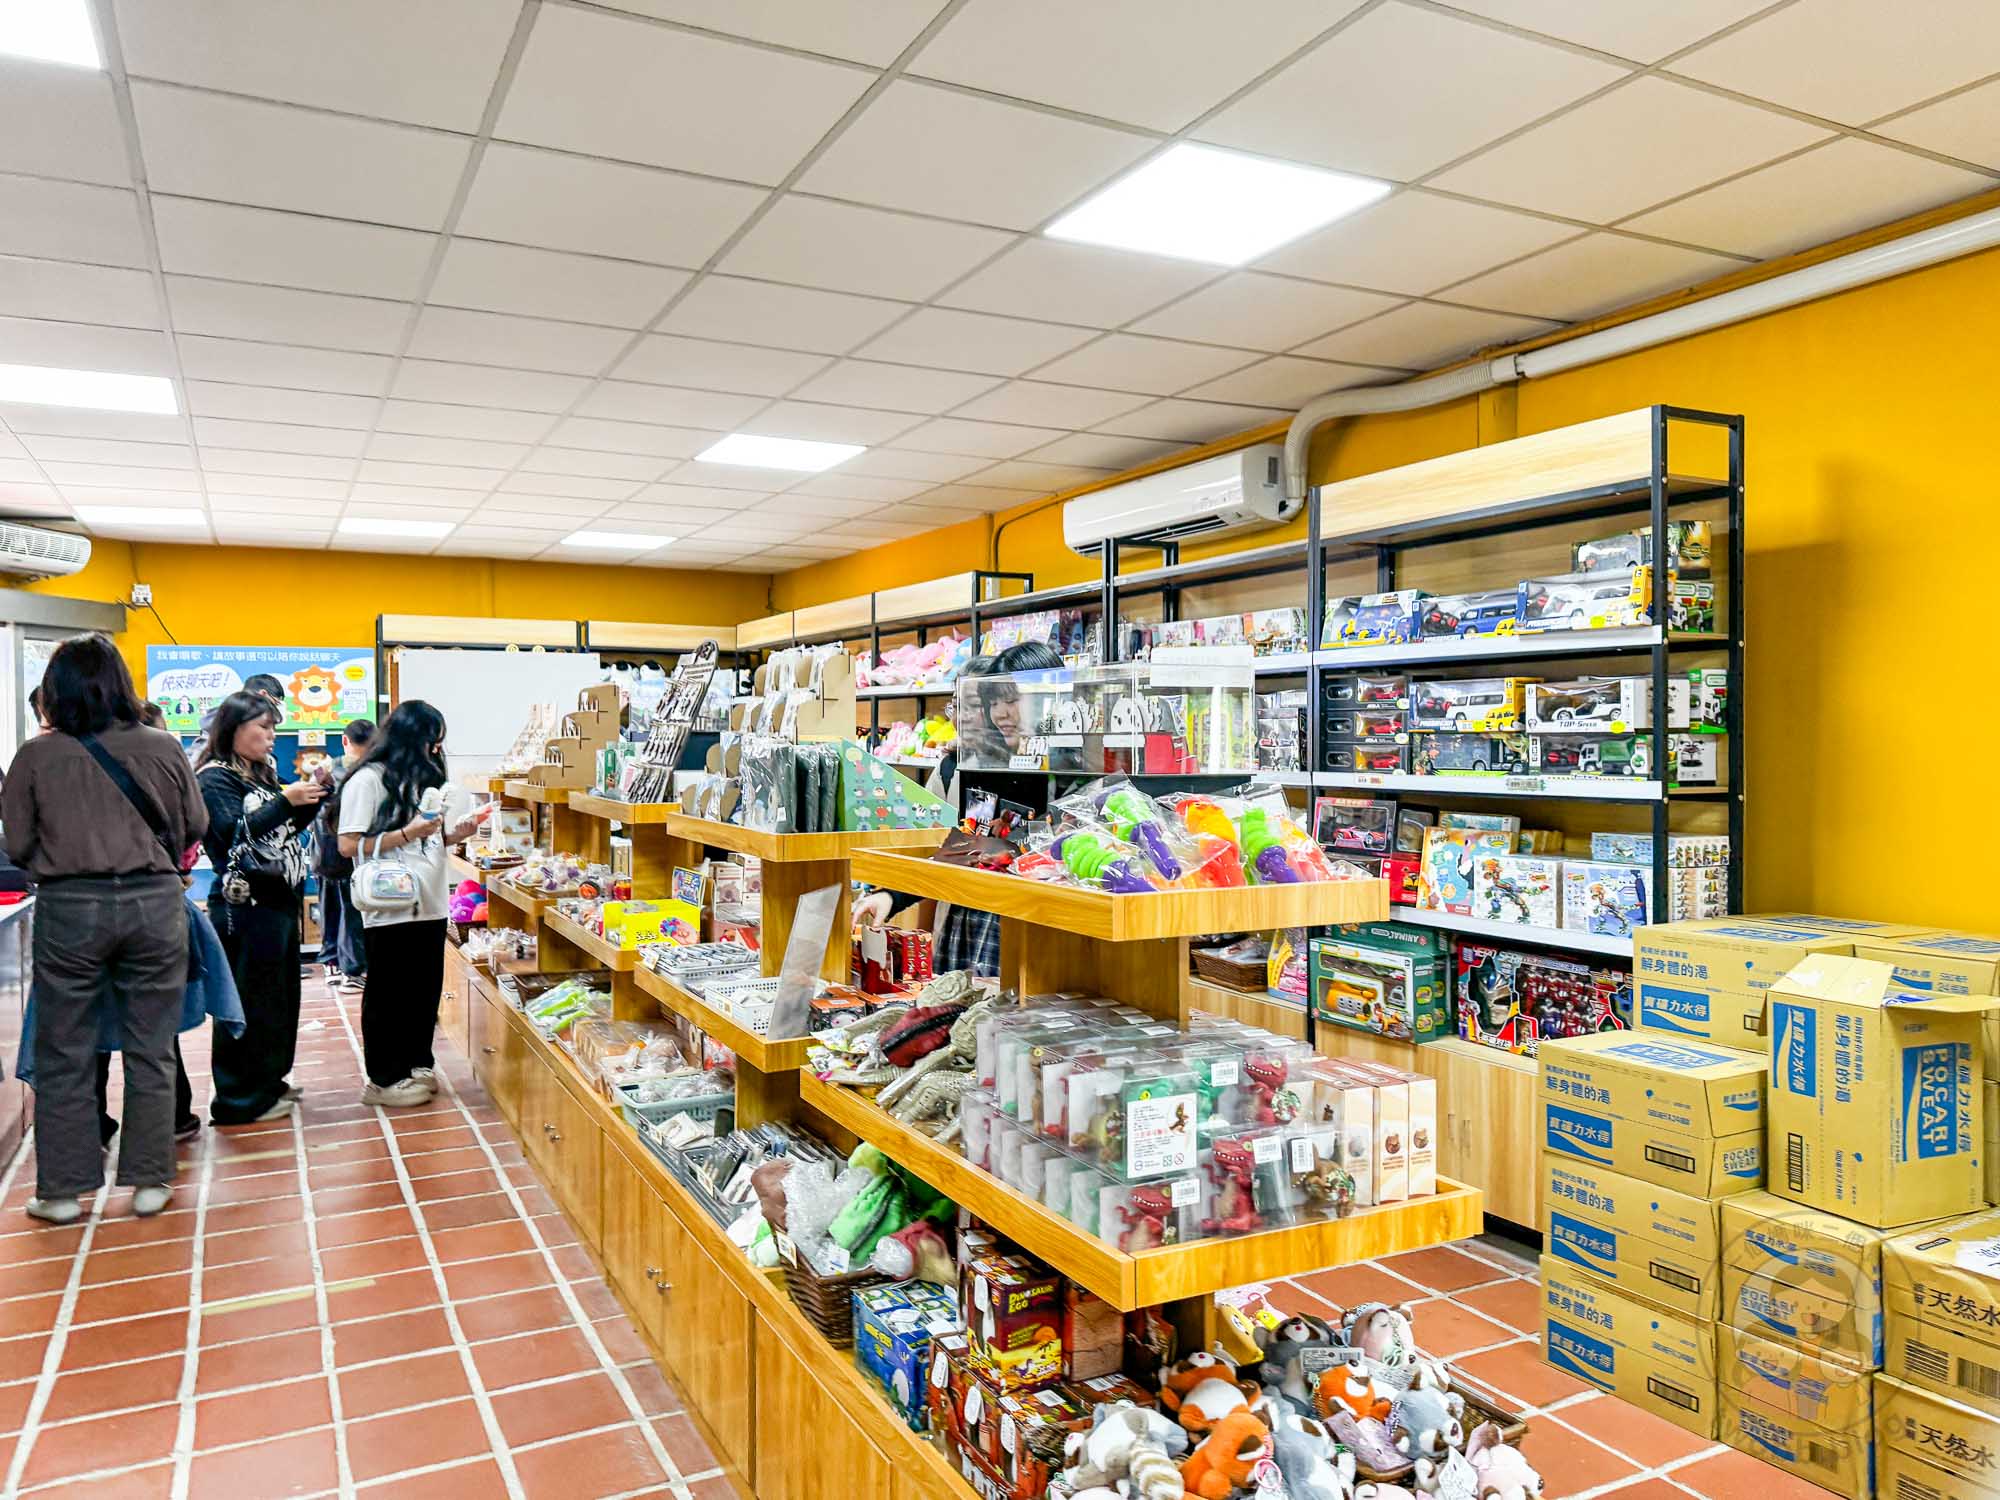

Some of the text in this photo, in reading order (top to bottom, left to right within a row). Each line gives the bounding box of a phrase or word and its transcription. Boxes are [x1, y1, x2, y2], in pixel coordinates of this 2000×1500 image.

[1641, 956, 1709, 980] 解身體的渴
[1643, 995, 1708, 1017] 寶礦力水得
[1835, 1014, 1852, 1104] 解身體的渴
[1545, 1075, 1611, 1105] 解身體的渴
[1922, 1049, 1936, 1145] SWEAT
[1934, 1047, 1949, 1154] POCARI
[1957, 1043, 1972, 1153] 寶礦力水得
[1550, 1117, 1610, 1144] 寶礦力水得
[1723, 1156, 1758, 1172] SWEAT
[1552, 1179, 1616, 1214] 解身體的渴
[1554, 1224, 1615, 1256] 寶礦力水得
[1008, 1299, 1029, 1314] EGG
[1548, 1290, 1614, 1330] 解身體的渴
[1741, 1285, 1795, 1313] POCARI
[1741, 1297, 1791, 1321] SWEAT
[1927, 1287, 2000, 1327] 天然水
[1551, 1332, 1613, 1369] 寶礦力水得
[1739, 1408, 1793, 1439] POCARI
[1740, 1419, 1788, 1446] SWEAT
[1919, 1423, 1998, 1469] 天然水
